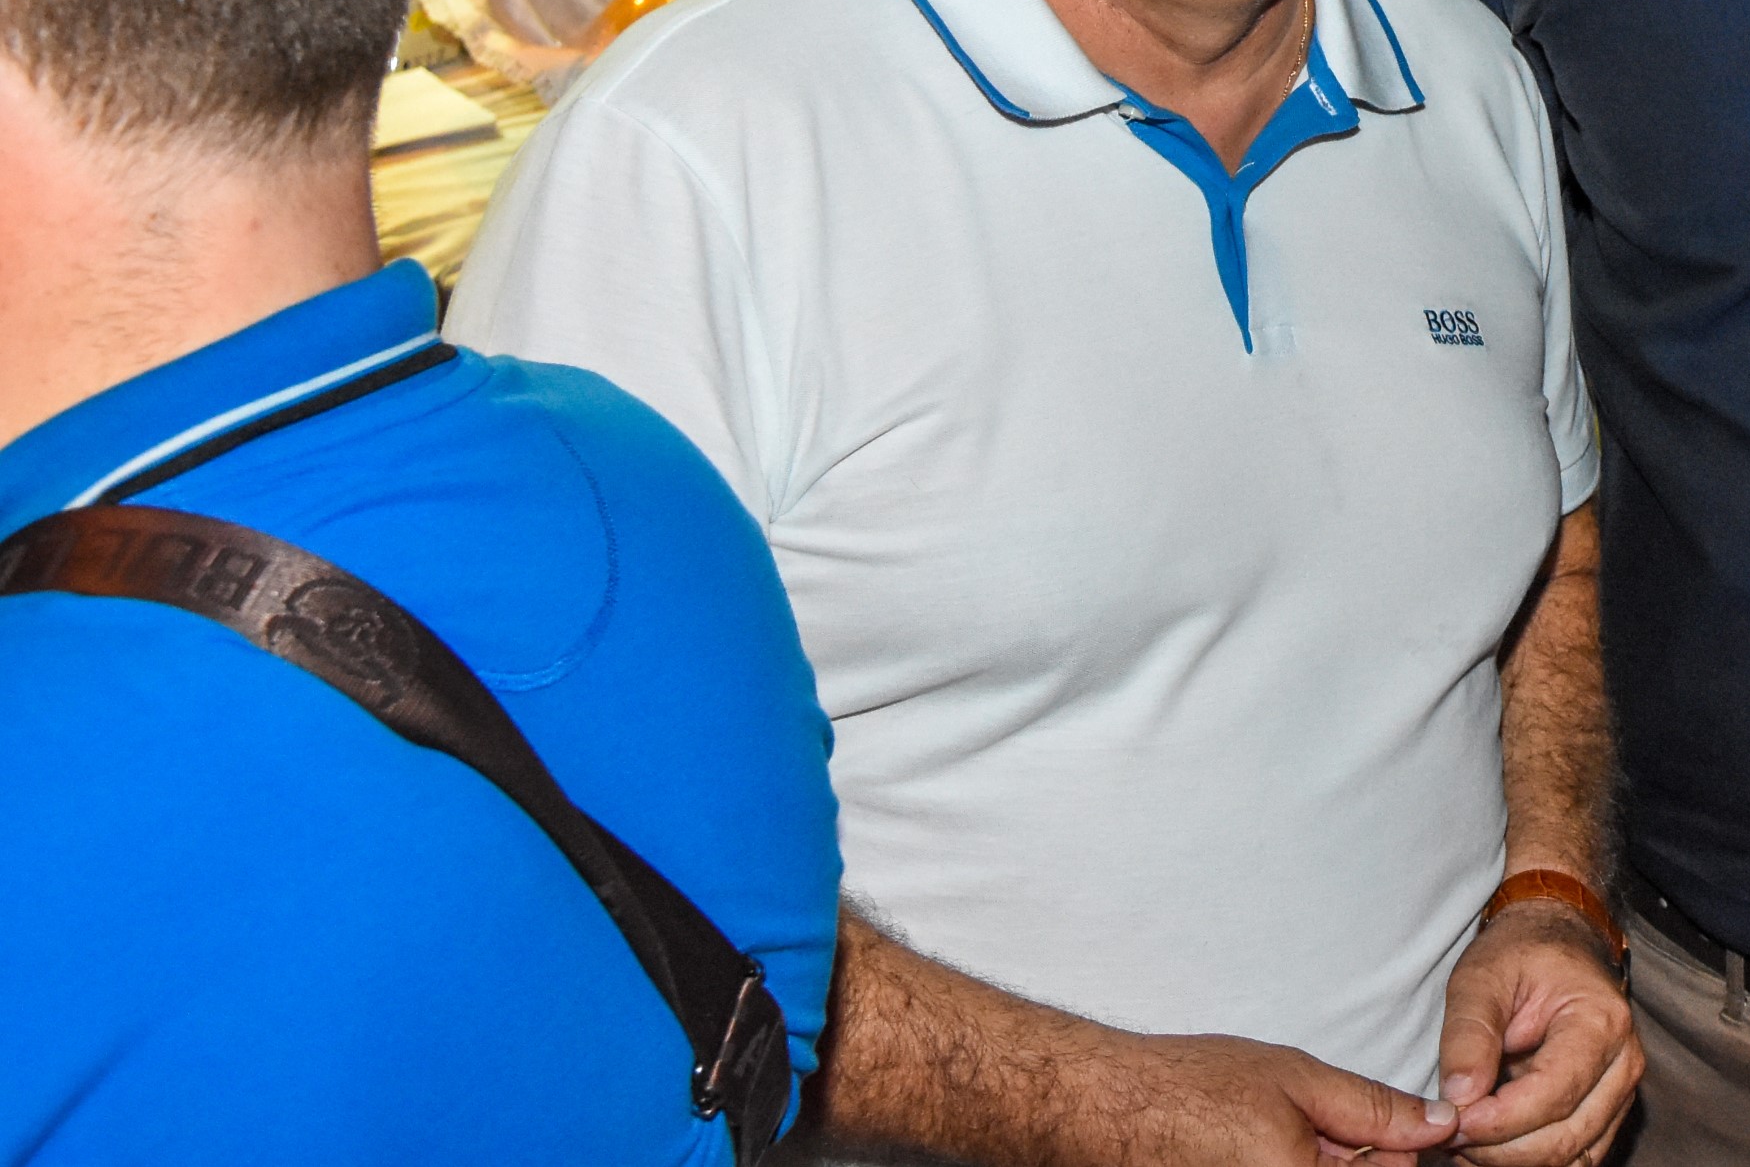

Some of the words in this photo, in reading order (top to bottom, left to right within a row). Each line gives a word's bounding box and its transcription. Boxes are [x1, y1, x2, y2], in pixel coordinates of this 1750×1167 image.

[1423, 309, 1480, 334] BOSS
[1431, 333, 1459, 346] HUGO
[1460, 334, 1484, 346] BOSS
